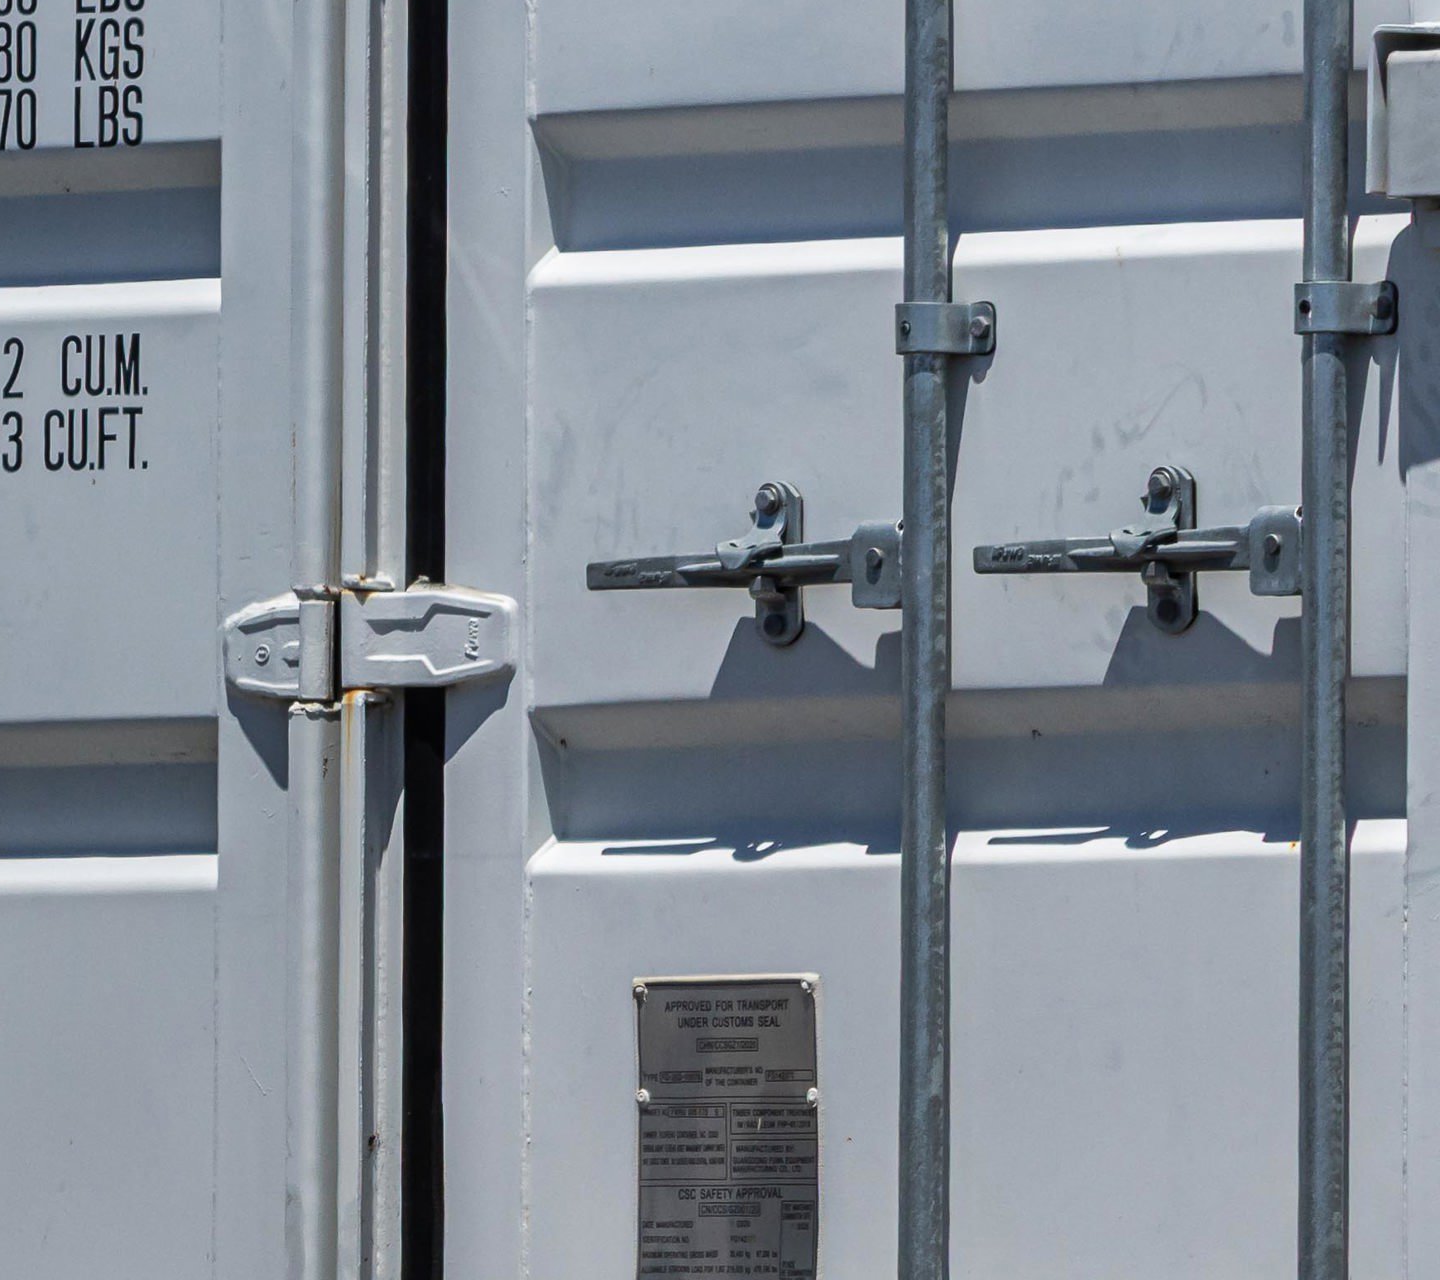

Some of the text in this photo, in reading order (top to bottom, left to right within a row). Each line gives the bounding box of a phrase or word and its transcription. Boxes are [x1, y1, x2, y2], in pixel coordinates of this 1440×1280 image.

[74, 17, 146, 83] KGS
[74, 85, 144, 150] LBS
[61, 332, 149, 398] CU.M.
[44, 406, 149, 472] CU.FT.
[664, 998, 790, 1013] APPROVED FOR TRANSPORT
[677, 1015, 781, 1029] UNDER CUSTOMS SEAL
[678, 1187, 784, 1201] CSC SAFETY APPROVAL
